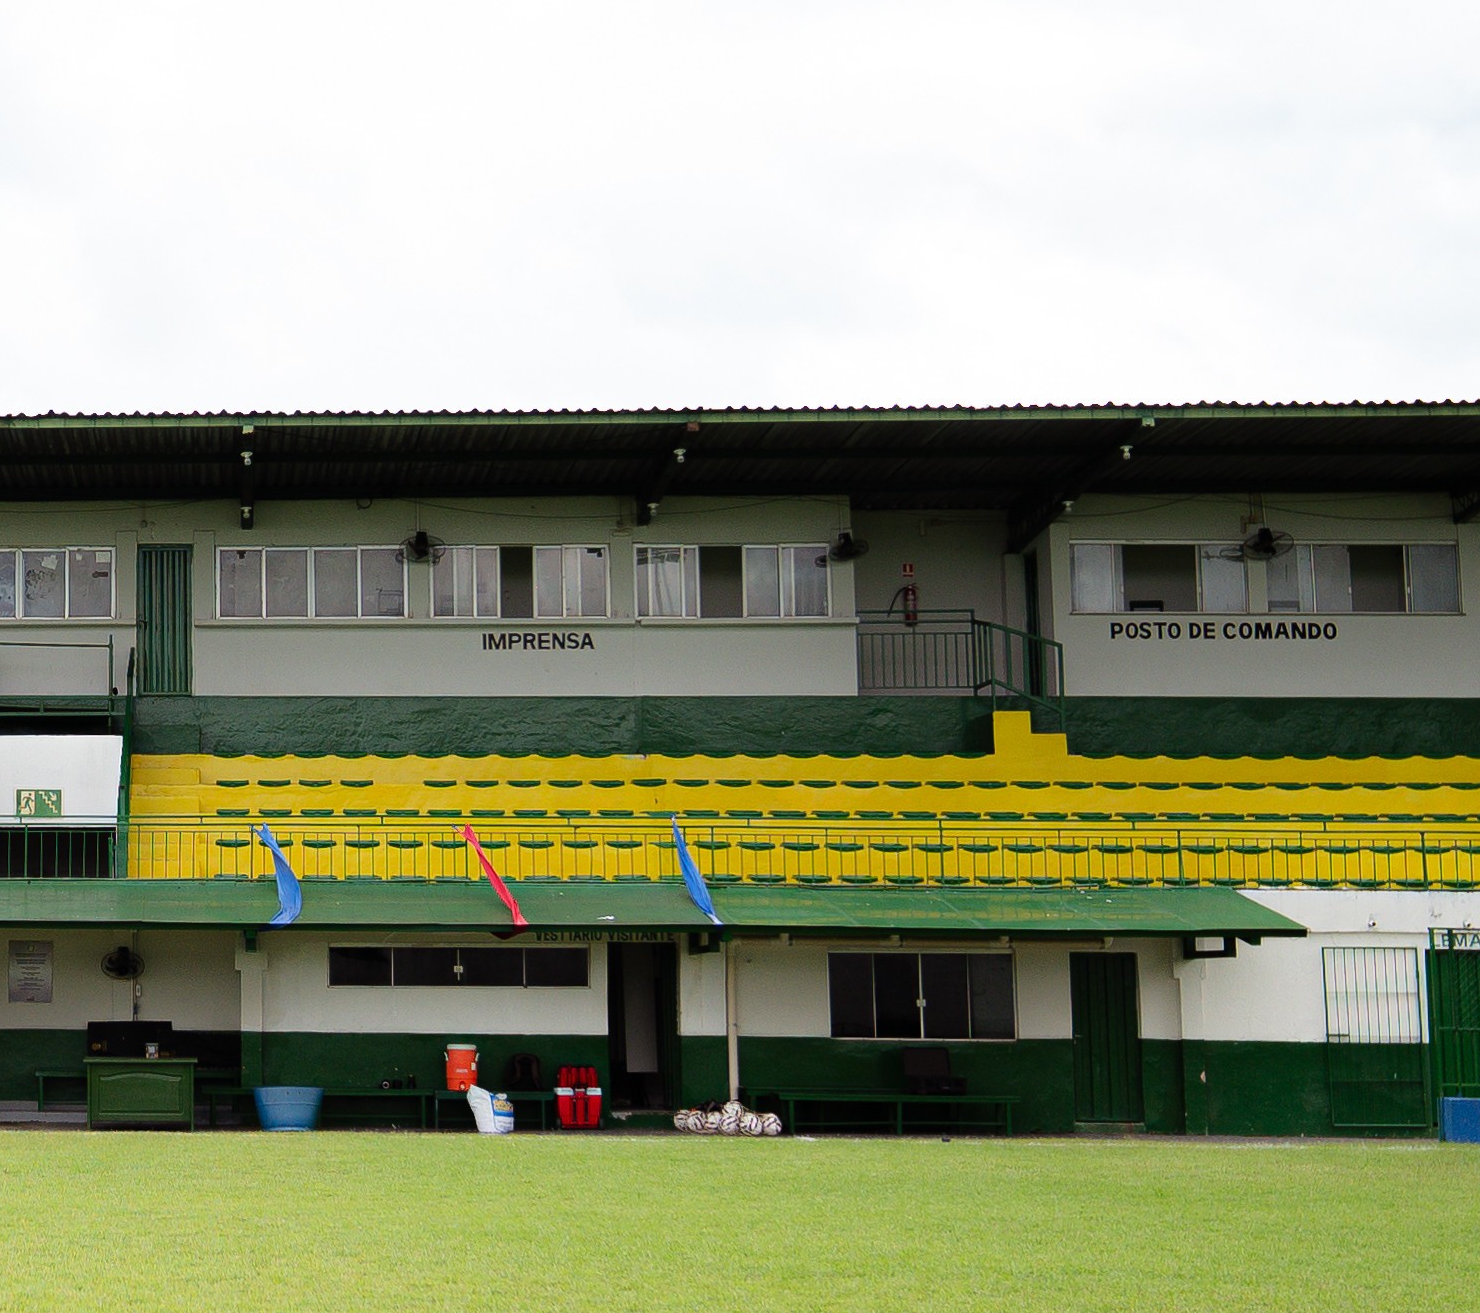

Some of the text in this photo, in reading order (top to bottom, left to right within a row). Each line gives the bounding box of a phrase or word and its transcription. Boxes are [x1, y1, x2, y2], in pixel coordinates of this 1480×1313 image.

[1110, 622, 1337, 639] POSTO DE COMANDO
[482, 632, 595, 650] IMPRENSA
